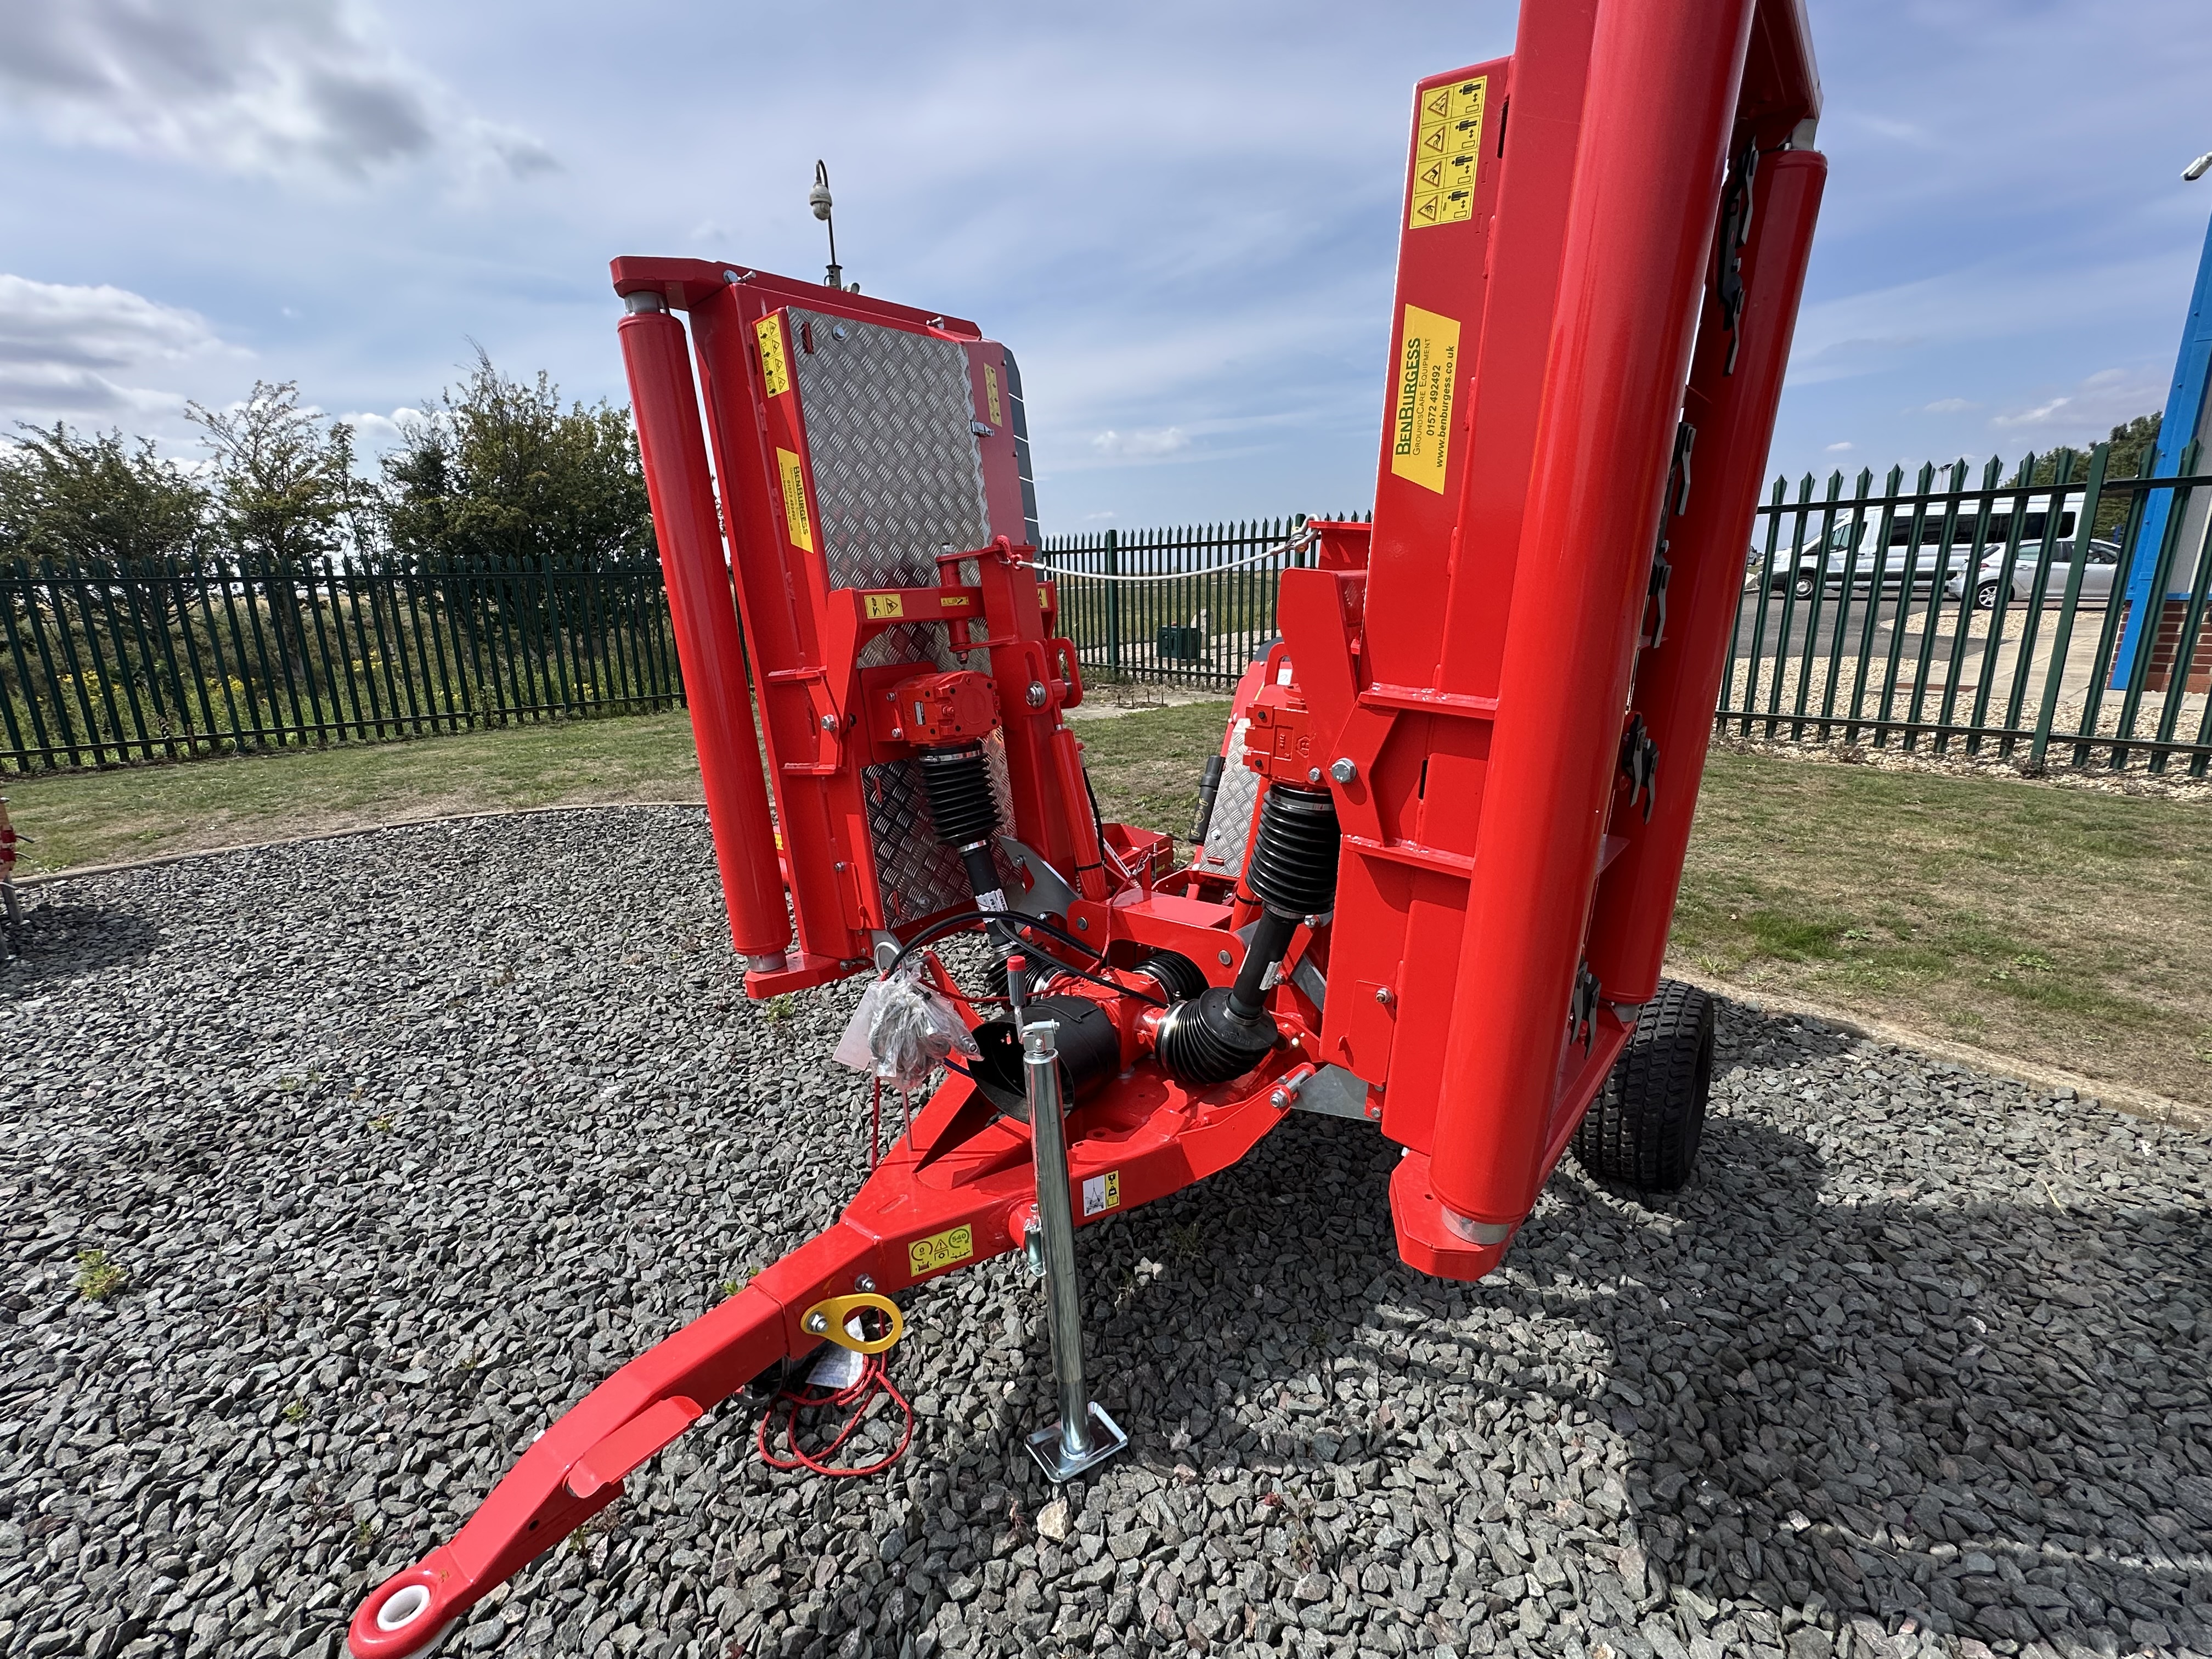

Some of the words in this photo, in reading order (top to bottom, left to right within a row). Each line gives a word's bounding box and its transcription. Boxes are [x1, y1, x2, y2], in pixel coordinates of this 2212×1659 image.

[1419, 338, 1431, 387] EQUIPMENT
[1431, 365, 1441, 403] 492492
[1426, 406, 1437, 436] 01572
[1436, 346, 1455, 467] www.benburgess.co.uk
